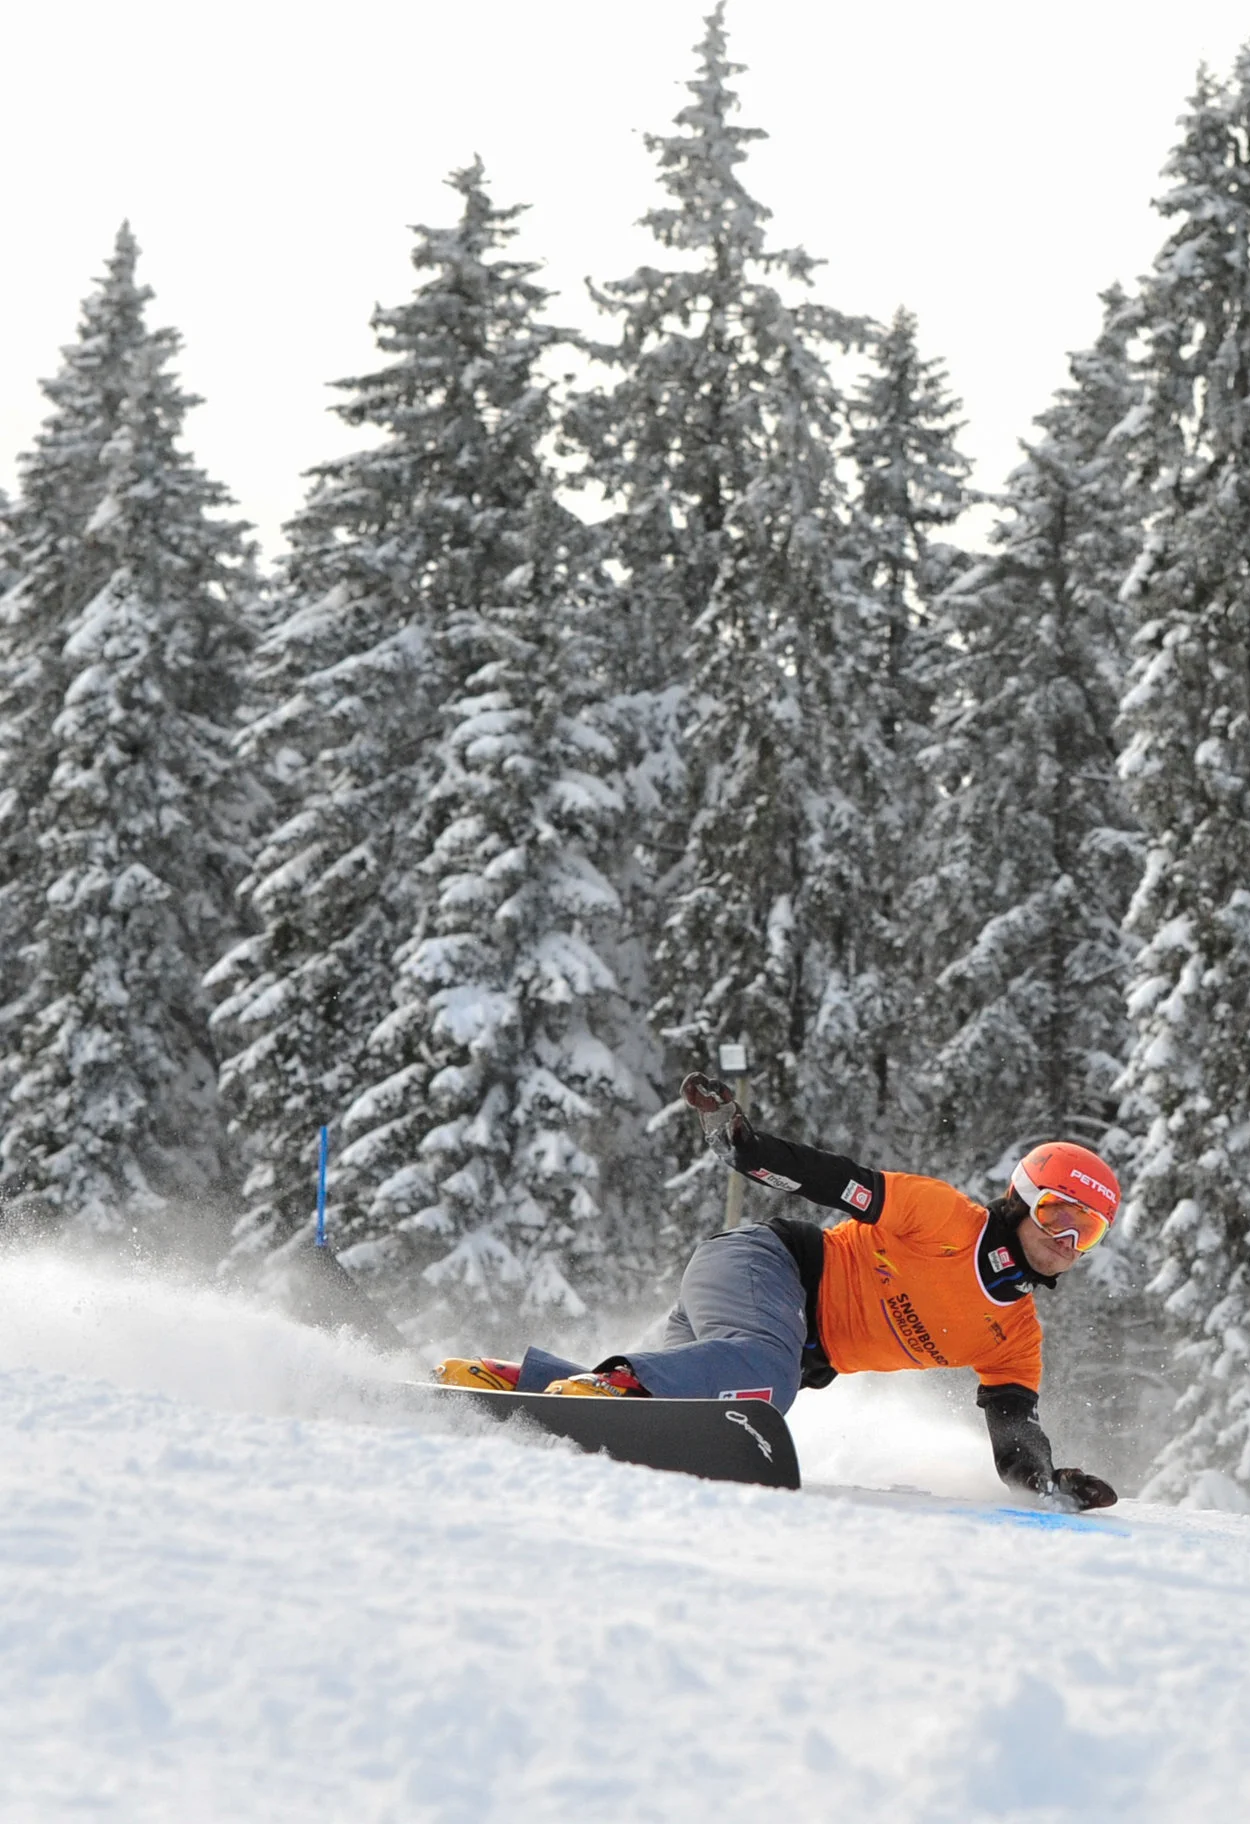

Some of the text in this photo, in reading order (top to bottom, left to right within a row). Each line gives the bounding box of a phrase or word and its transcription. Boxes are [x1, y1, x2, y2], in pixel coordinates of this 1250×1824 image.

[1070, 1169, 1117, 1204] PETROL
[887, 1296, 925, 1353] WORLD CUP
[895, 1292, 949, 1366] SNOWBOARD
